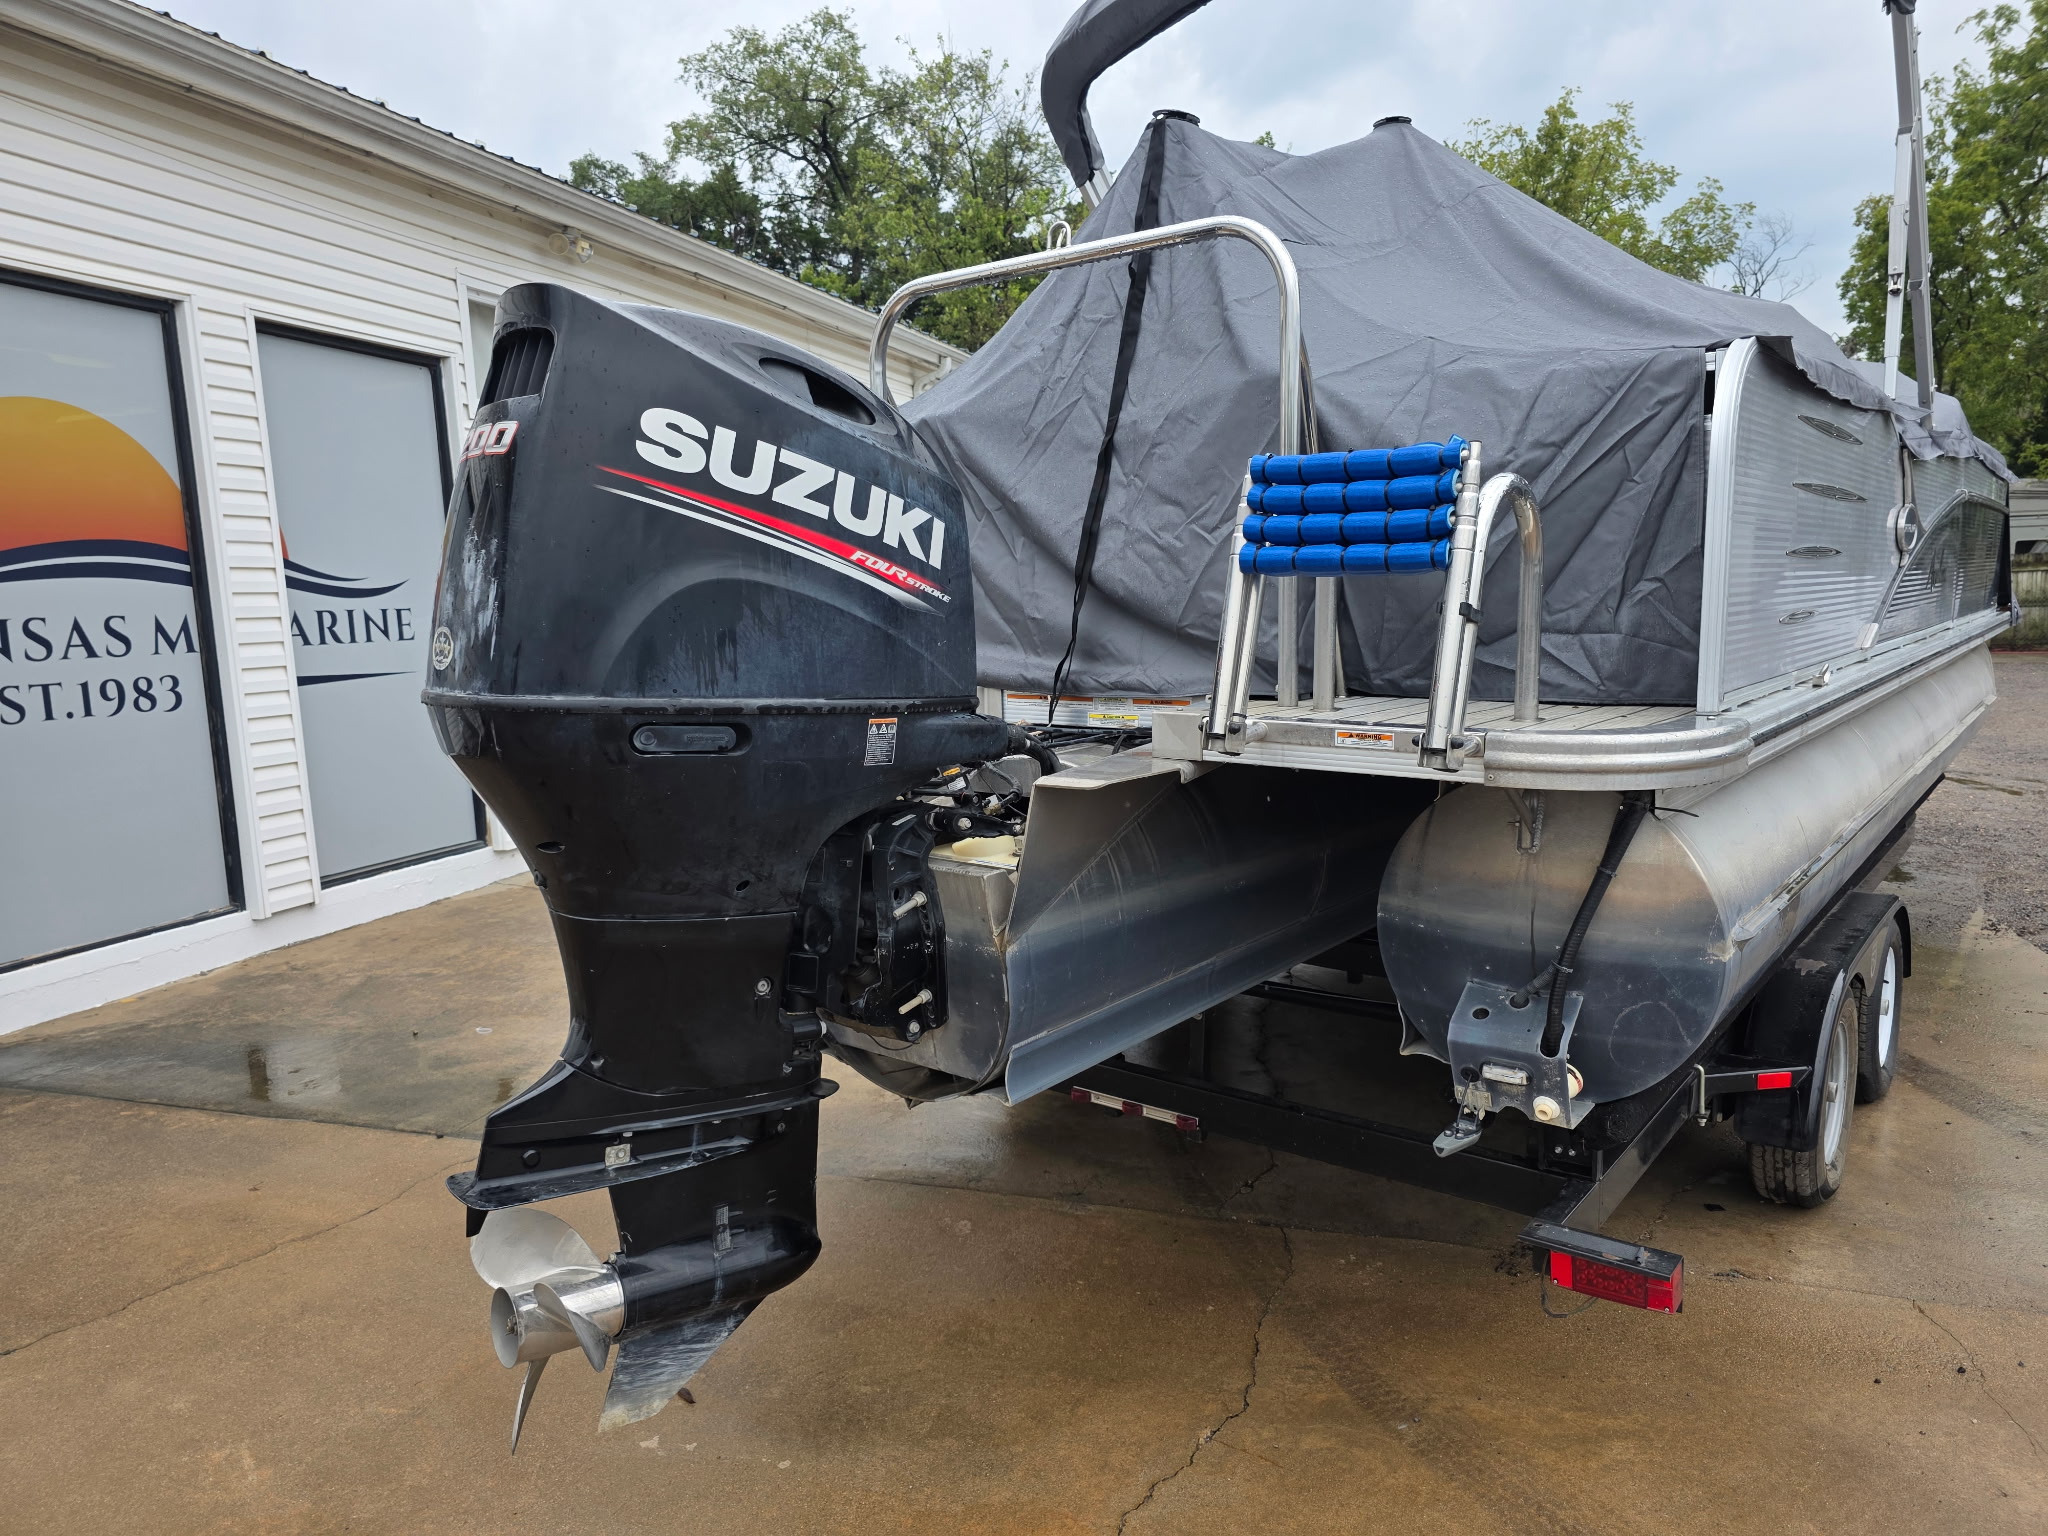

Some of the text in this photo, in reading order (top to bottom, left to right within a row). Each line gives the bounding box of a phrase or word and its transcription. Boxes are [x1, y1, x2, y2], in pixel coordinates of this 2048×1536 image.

[460, 420, 519, 463] 00
[635, 407, 946, 570] SUZUKI
[850, 550, 952, 603] FOUR STROKE
